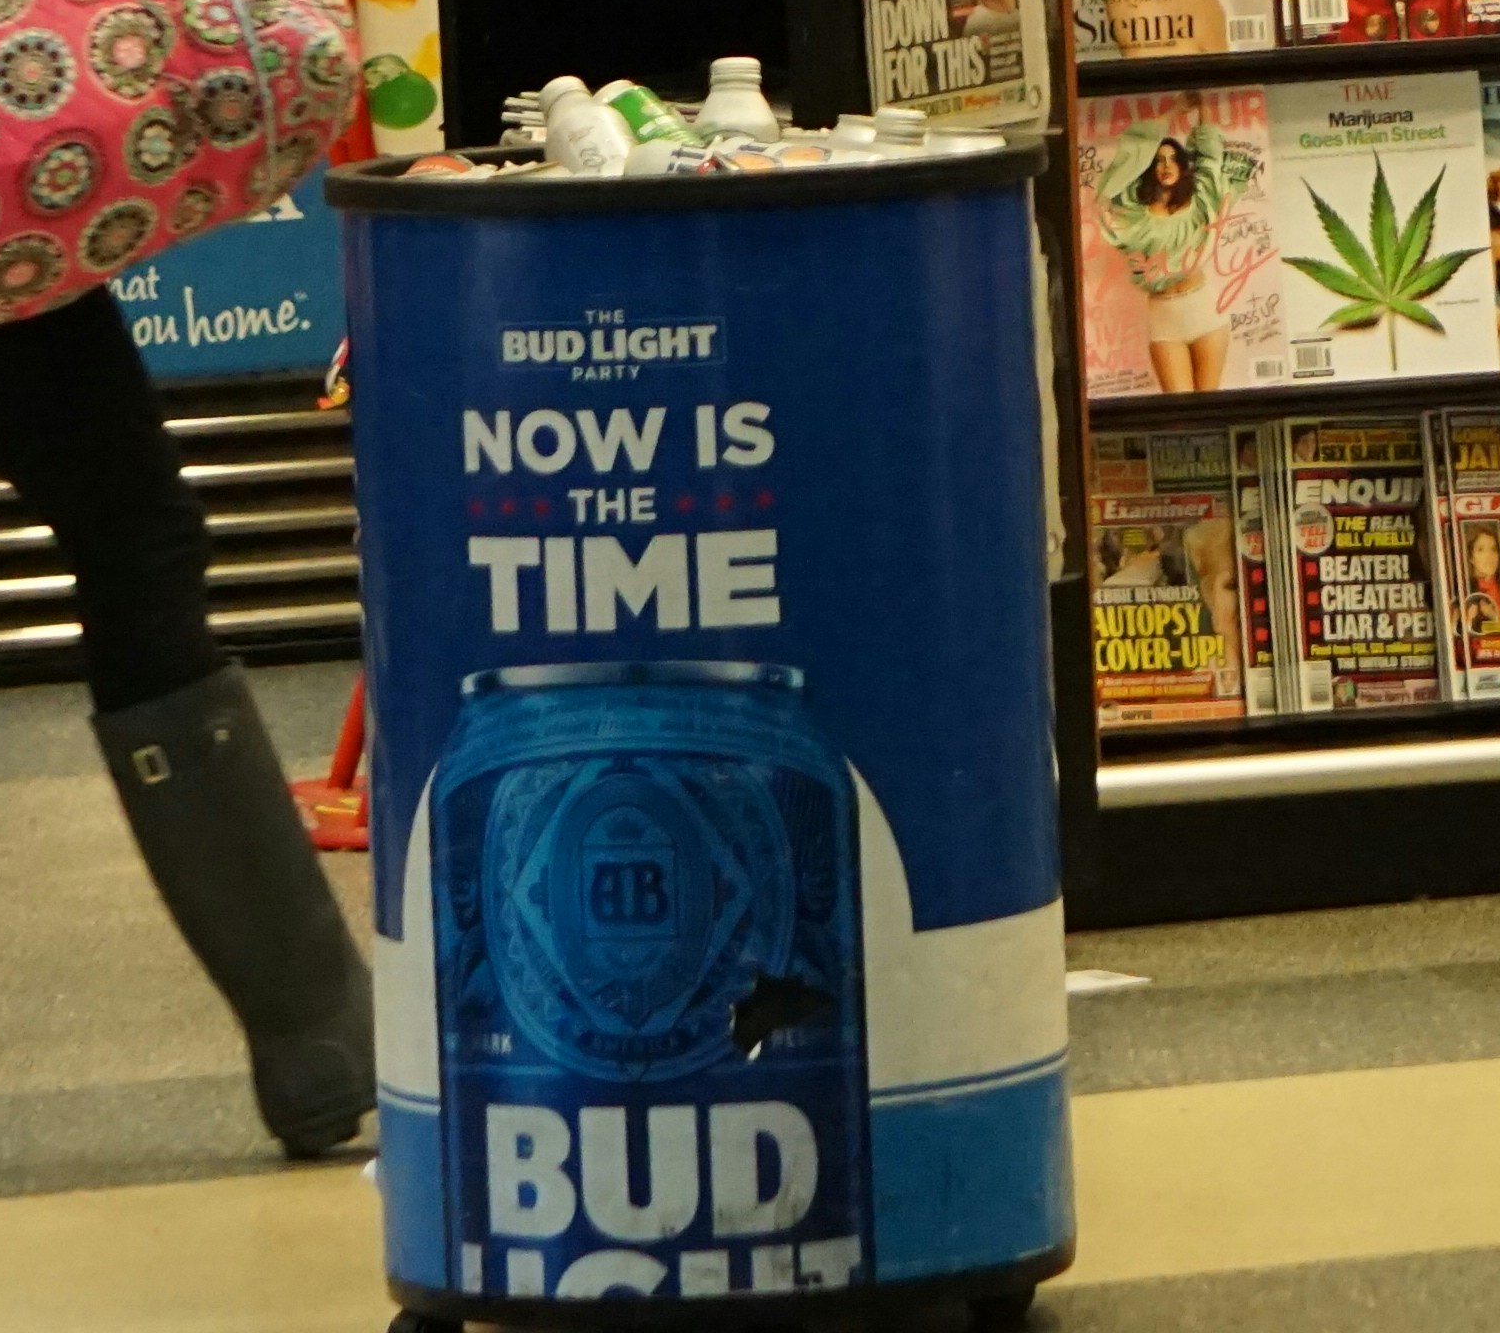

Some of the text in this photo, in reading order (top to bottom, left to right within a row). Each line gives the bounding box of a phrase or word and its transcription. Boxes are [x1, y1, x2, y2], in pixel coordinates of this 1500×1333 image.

[1073, 12, 1195, 48] Sienna
[1339, 81, 1397, 103] TIME
[1328, 107, 1415, 129] Marijuana
[184, 285, 312, 348] home.
[570, 363, 642, 383] PARTY
[463, 401, 776, 473] NOW IS
[567, 486, 658, 525] THE
[1103, 498, 1210, 520] Examiner
[467, 528, 781, 634] TIME
[1319, 555, 1410, 582] BEATER!
[1320, 583, 1426, 611] CHEATER!
[1095, 603, 1202, 639] AUTOPSY
[1096, 634, 1226, 673] COVER-UP!
[485, 1099, 819, 1241] BUD
